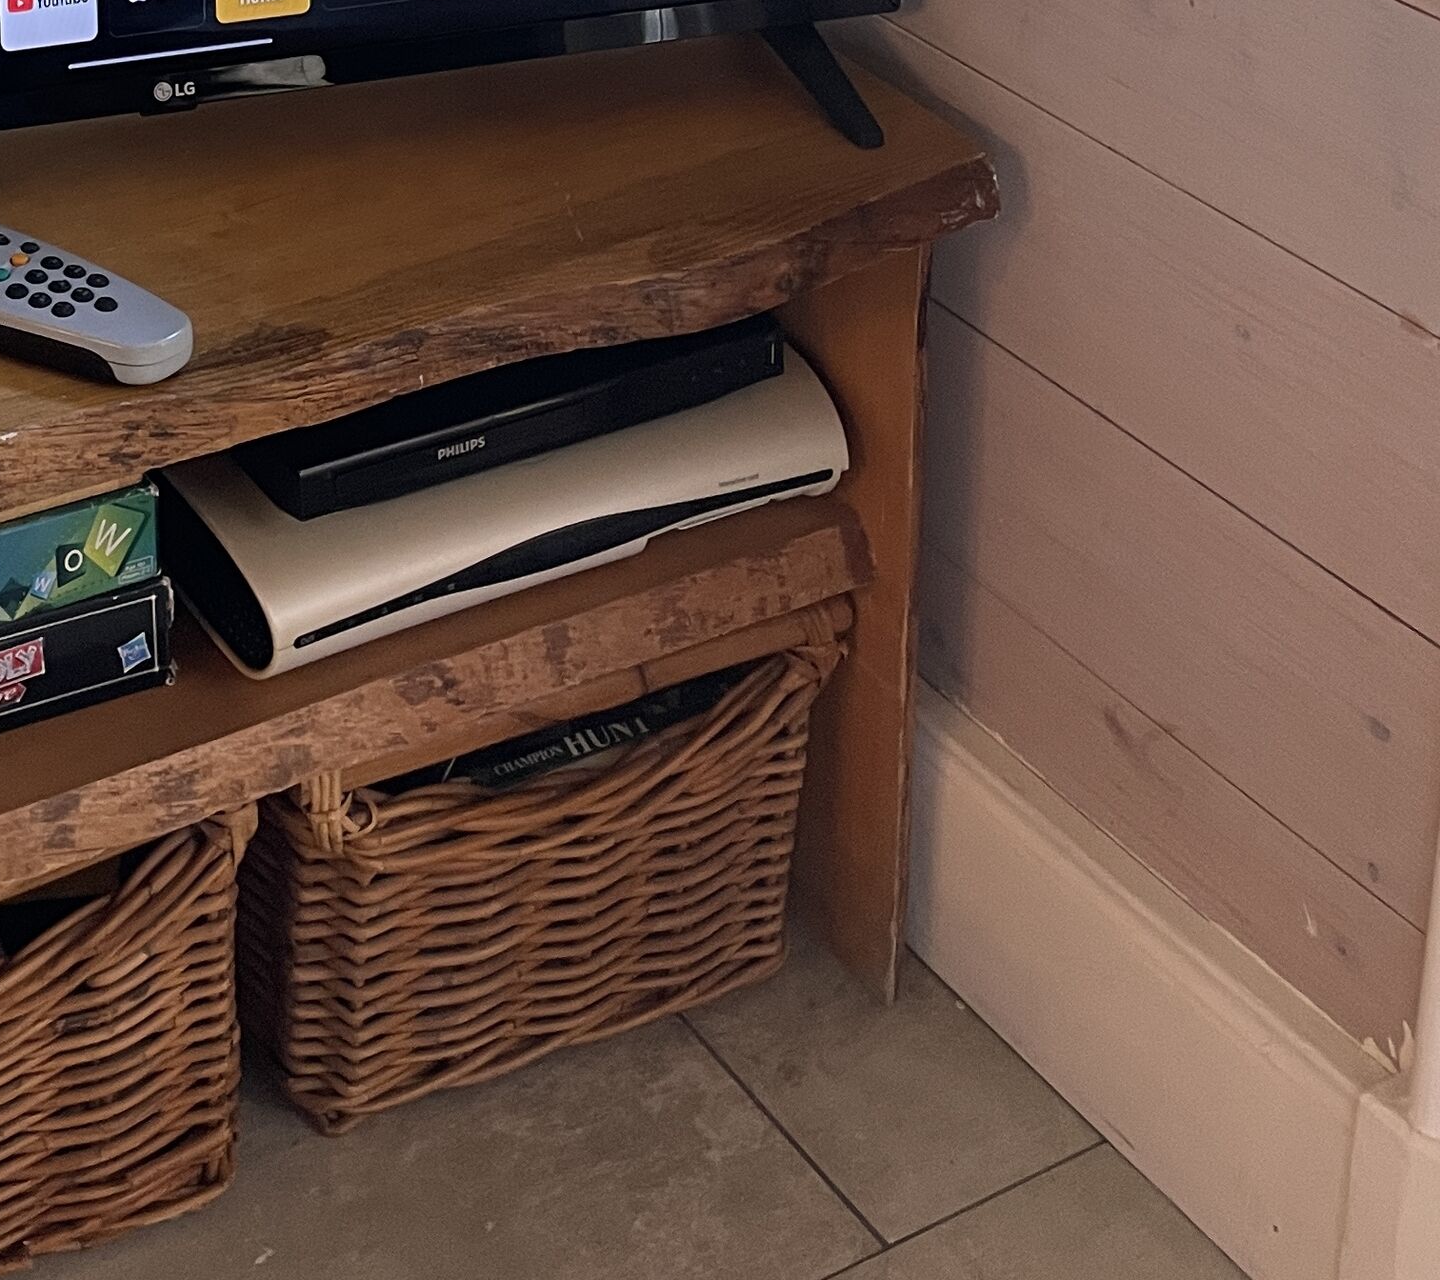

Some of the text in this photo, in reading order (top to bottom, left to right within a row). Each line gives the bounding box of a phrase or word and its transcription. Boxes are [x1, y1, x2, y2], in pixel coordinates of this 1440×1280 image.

[174, 81, 196, 97] LG
[436, 435, 486, 460] PHILIPS
[493, 744, 563, 777] CHAMPION
